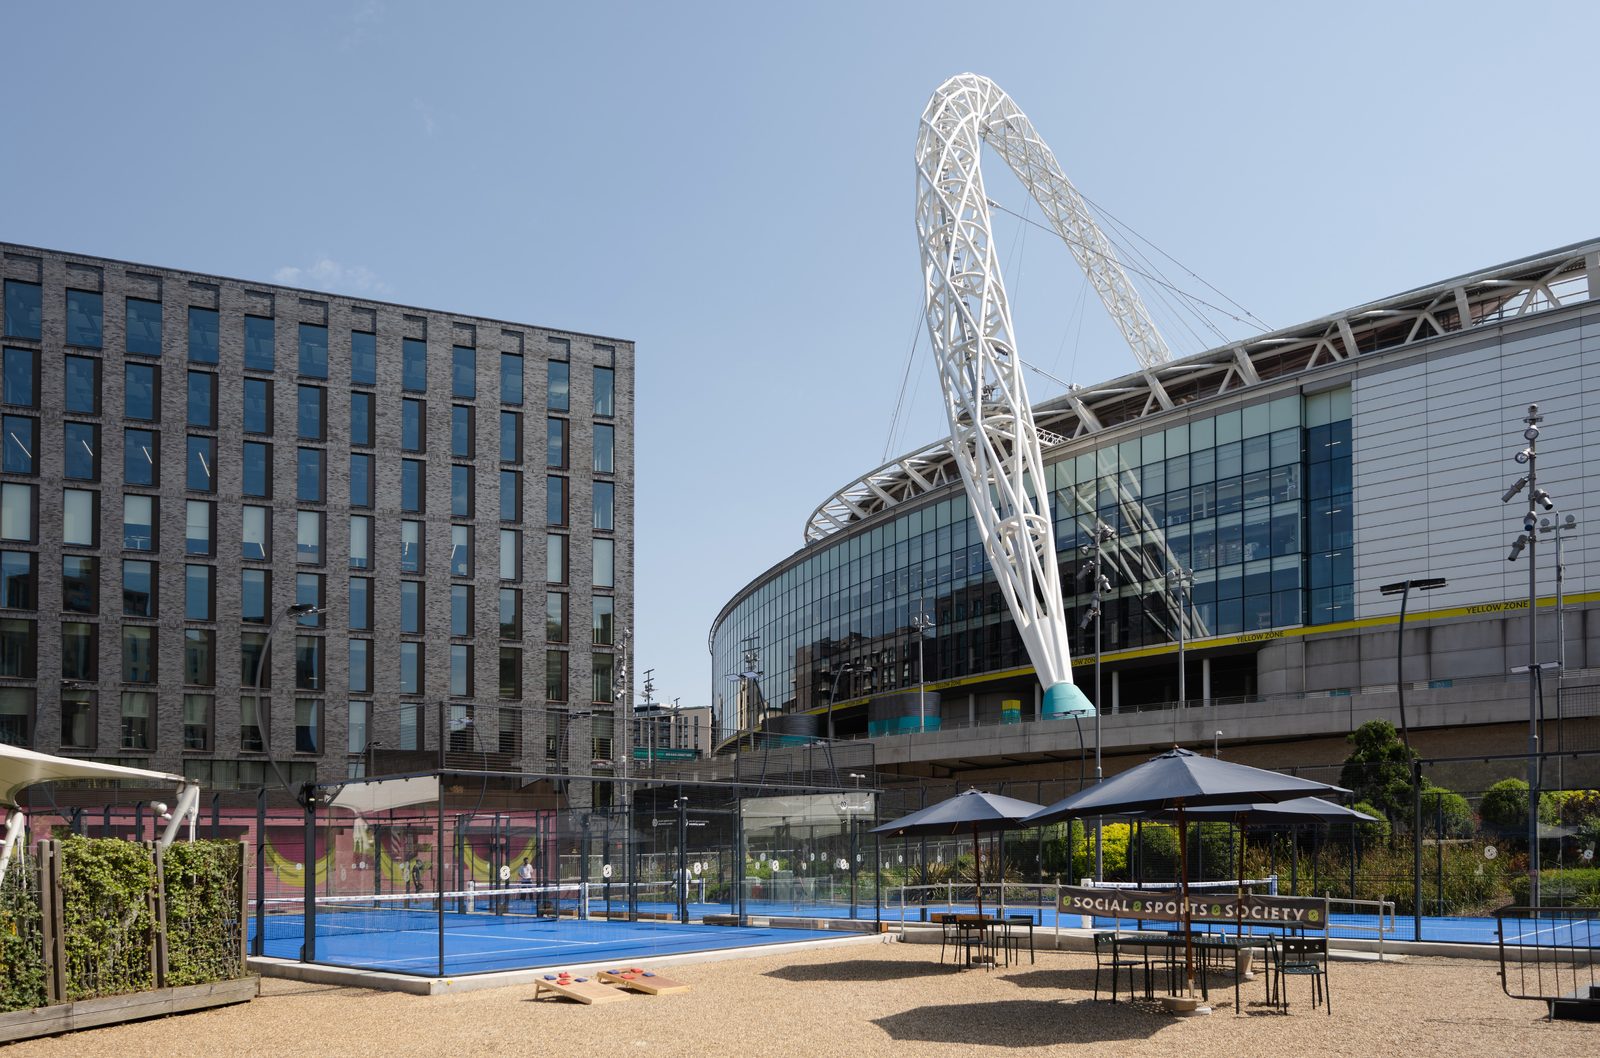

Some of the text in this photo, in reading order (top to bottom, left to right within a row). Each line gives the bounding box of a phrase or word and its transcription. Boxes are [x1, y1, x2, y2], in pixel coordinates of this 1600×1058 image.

[1466, 601, 1529, 613] YELLOW ZONE
[1236, 631, 1284, 642] YELLOW ZONE
[1074, 897, 1129, 912] SOCIAL
[1225, 904, 1304, 920] SOCIETY
